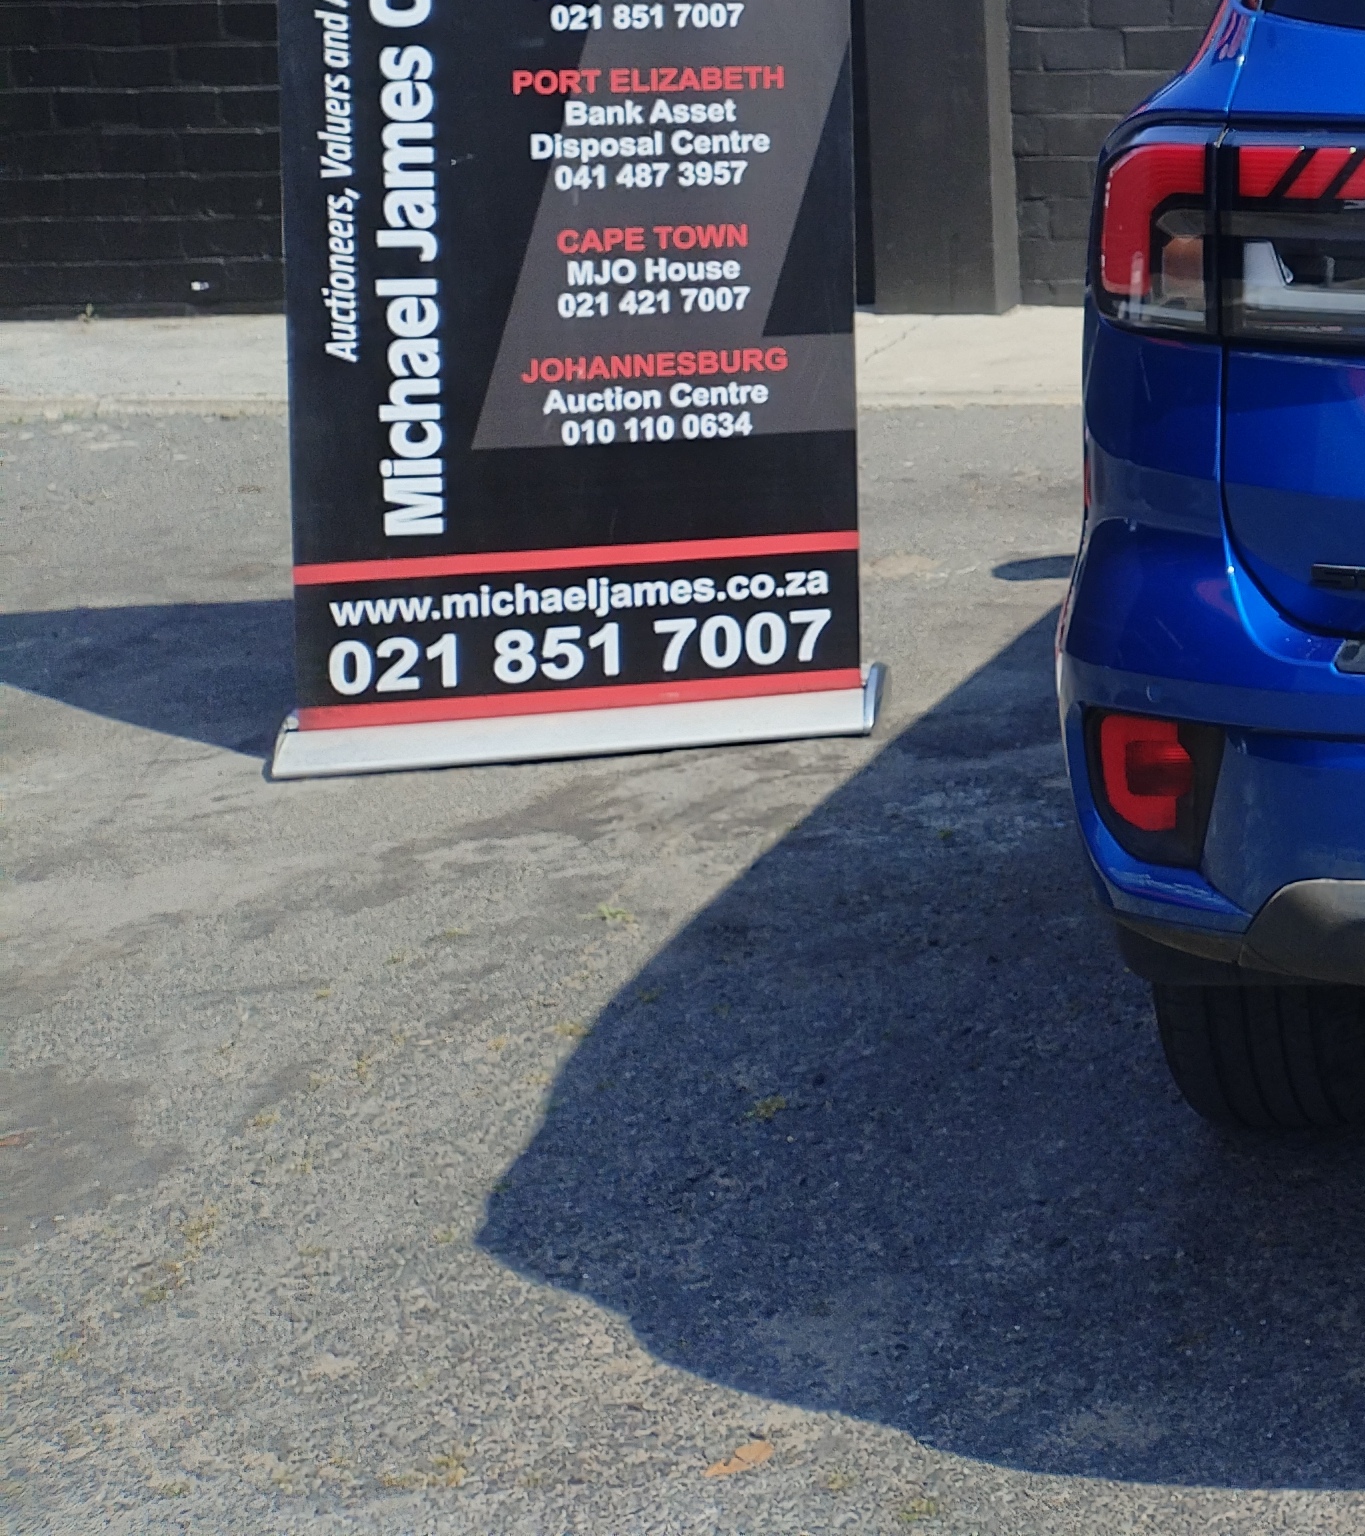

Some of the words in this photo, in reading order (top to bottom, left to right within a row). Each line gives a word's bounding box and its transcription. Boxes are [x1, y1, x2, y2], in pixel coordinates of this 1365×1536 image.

[550, 4, 603, 31] 021
[612, 3, 664, 30] 851
[673, 2, 745, 29] 7007
[316, 9, 350, 68] and
[512, 69, 601, 95] PORT
[609, 65, 785, 93] ELIZABETH
[316, 73, 353, 178] Valuers
[565, 99, 645, 127] Bank
[649, 98, 737, 124] Asset
[376, 44, 438, 262] James
[530, 130, 663, 164] Disposal
[670, 129, 771, 156] Centre
[554, 163, 606, 191] 041
[615, 162, 671, 188] 487
[678, 159, 749, 187] 3957
[556, 227, 645, 254] CAPE
[653, 224, 748, 250] TOWN
[321, 187, 361, 363] Auctioneers,
[567, 258, 637, 286] MJO
[644, 257, 741, 283] House
[557, 291, 609, 319] 021
[618, 288, 670, 316] 421
[680, 285, 751, 313] 7007
[521, 346, 789, 384] JOHANNESBURG
[375, 278, 444, 536] Michael
[542, 385, 662, 415] Auction
[669, 381, 769, 408] Centre
[561, 418, 616, 446] 010
[623, 414, 675, 443] 110
[681, 410, 754, 440] 0634
[329, 570, 832, 628] www.michaeljames.co.za
[329, 633, 458, 695] 021
[493, 622, 620, 684] 851
[653, 608, 832, 672] 7007
